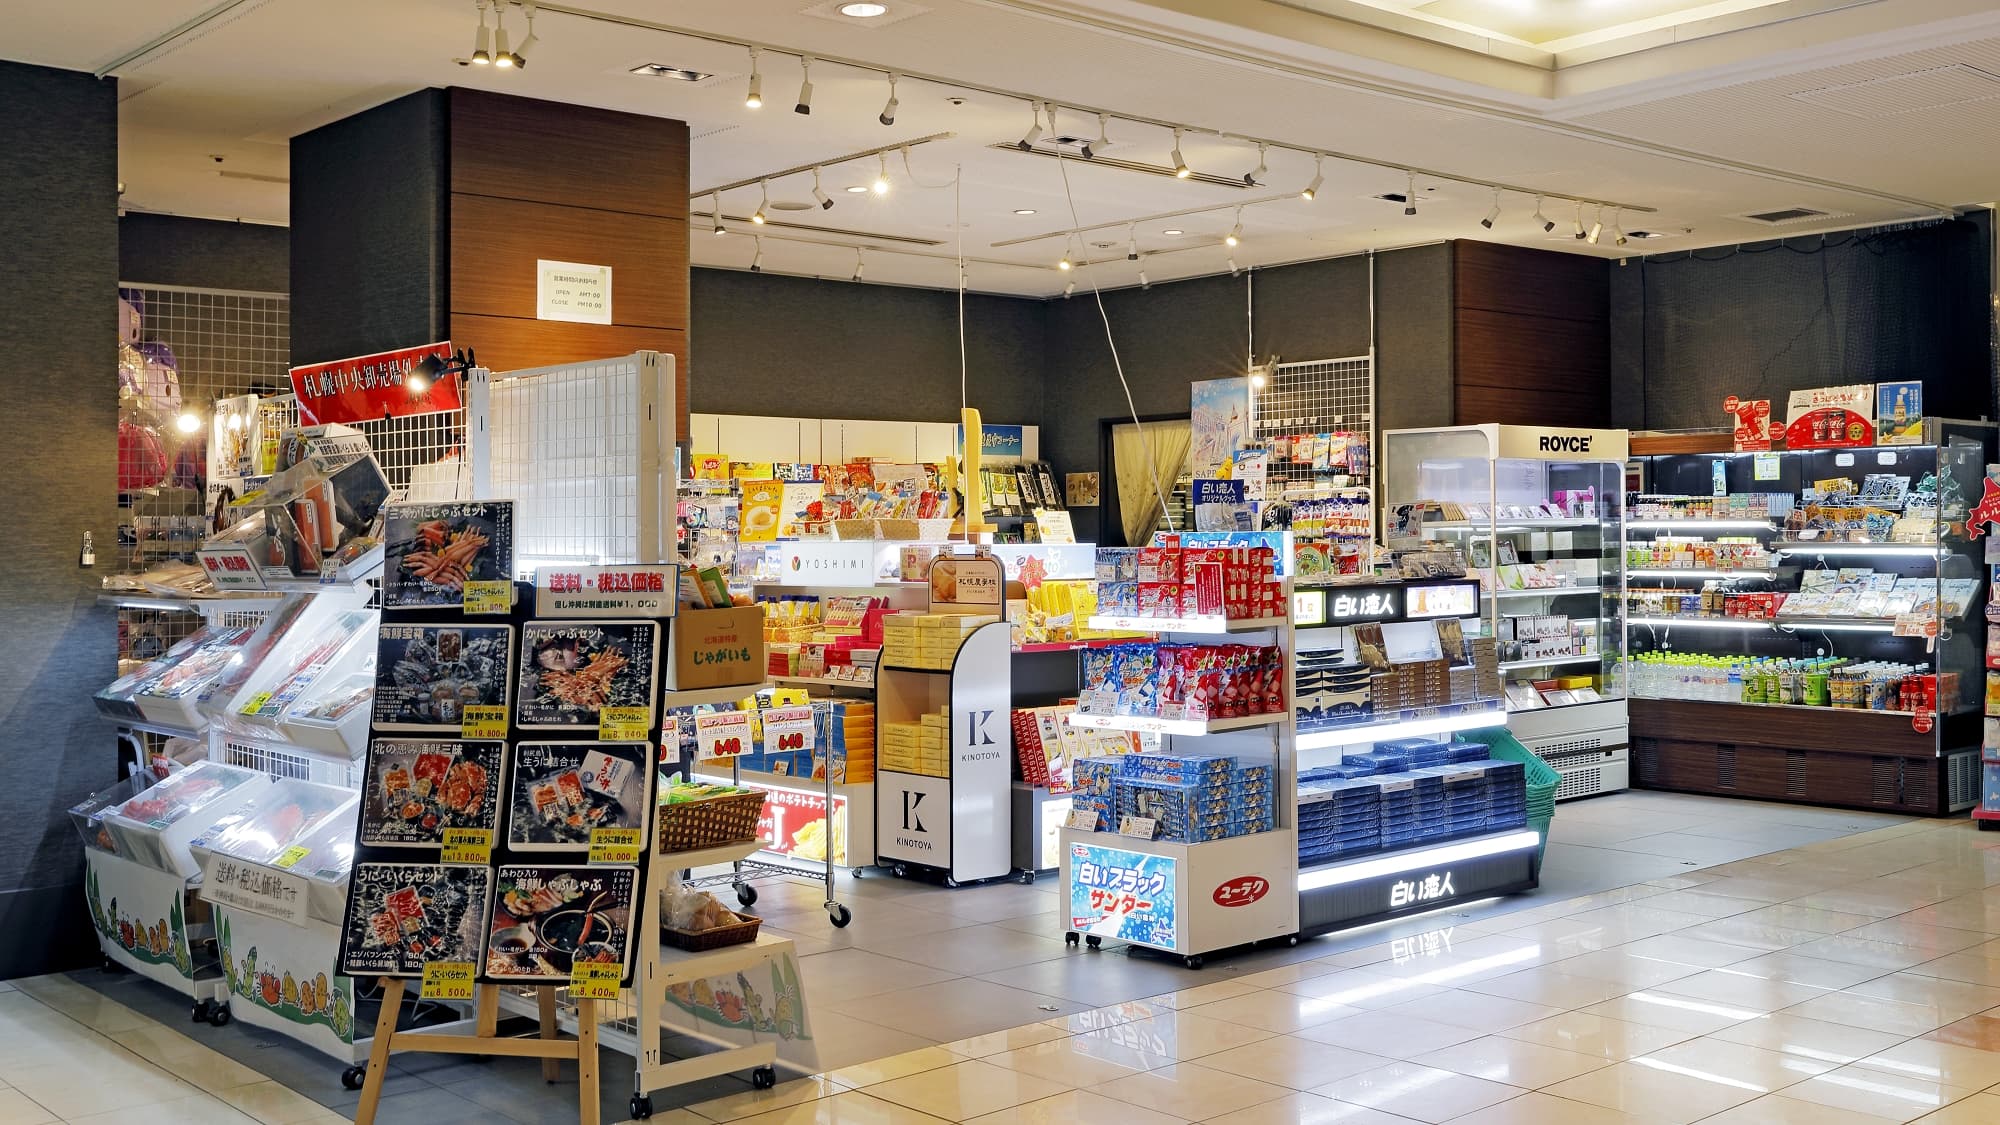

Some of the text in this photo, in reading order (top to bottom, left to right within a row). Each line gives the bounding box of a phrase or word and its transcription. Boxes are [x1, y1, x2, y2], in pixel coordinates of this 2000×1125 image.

[1539, 435, 1592, 453] ROYCE'
[1202, 482, 1236, 494] 白い恋人
[805, 559, 865, 569] YOSHIMI
[548, 572, 665, 594] 送料・税込価格
[1333, 592, 1394, 617] 白い恋人
[379, 628, 425, 640] 海鮮宝箱
[525, 628, 606, 641] かにしゃぶセット
[693, 646, 752, 667] じゃがいも
[465, 712, 504, 721] 海鮮宝箱
[967, 710, 996, 747] K
[961, 751, 1001, 763] KINOTOYA
[1018, 714, 1041, 782] HOKKAI KOGANE
[1027, 713, 1050, 783] HOKKAI KOGANE
[522, 756, 580, 768] 生うに詰合せ
[902, 789, 928, 834] K
[596, 836, 634, 845] 生うに詰合せ
[896, 836, 933, 851] KINOTOYA
[500, 869, 538, 879] あわび入り
[1079, 860, 1167, 897] 白いブラック
[516, 878, 603, 892] 海鮮しゃぶしゃぶ
[1218, 879, 1265, 900] ユーラク
[1390, 871, 1456, 907] 白い恋人
[1090, 889, 1152, 915] サンダー
